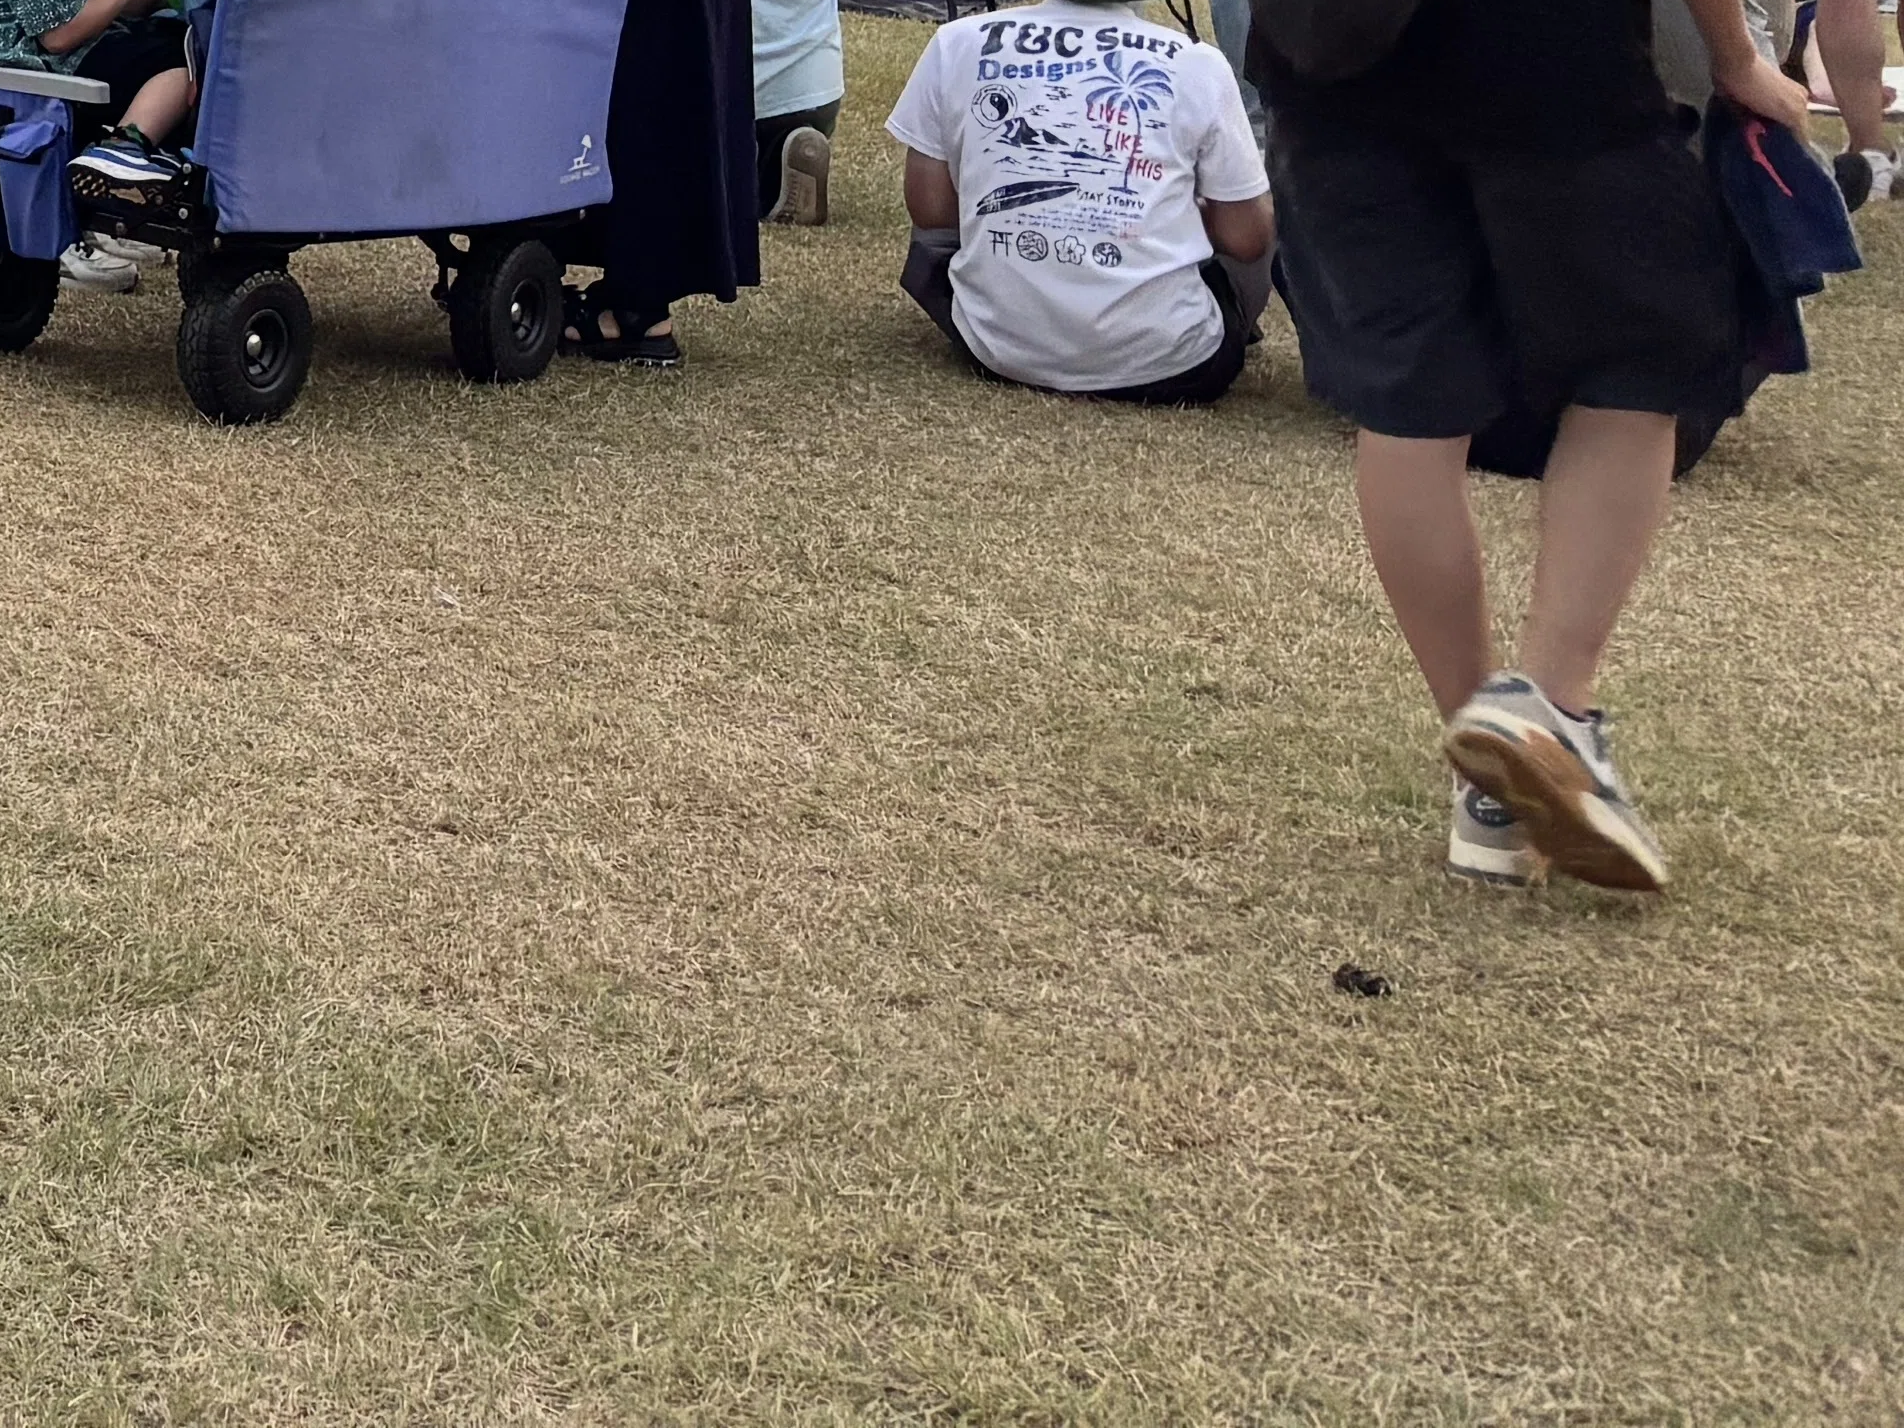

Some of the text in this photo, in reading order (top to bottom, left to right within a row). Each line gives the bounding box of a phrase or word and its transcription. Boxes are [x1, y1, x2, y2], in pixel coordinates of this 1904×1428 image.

[979, 20, 1183, 60] T&C Surf
[976, 56, 1098, 82] Designs
[1086, 103, 1129, 127] LIVE
[1103, 129, 1145, 157] LIKE
[1128, 156, 1164, 181] THIS
